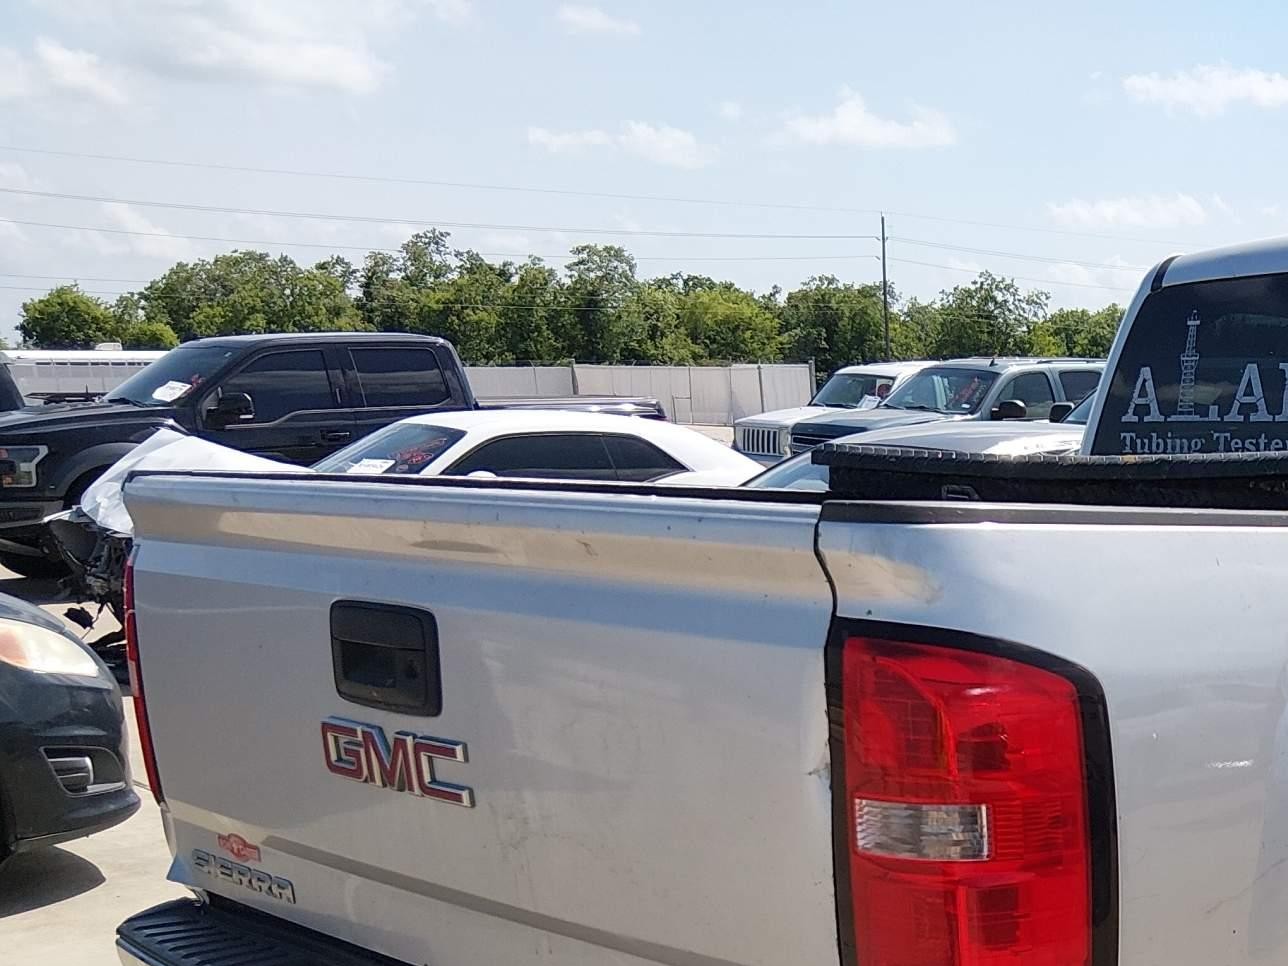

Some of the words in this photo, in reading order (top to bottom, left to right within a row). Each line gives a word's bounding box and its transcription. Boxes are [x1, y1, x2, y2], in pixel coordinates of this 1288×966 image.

[1120, 432, 1205, 453] Tubing
[320, 716, 476, 809] GMC
[192, 849, 296, 904] SIERRA
